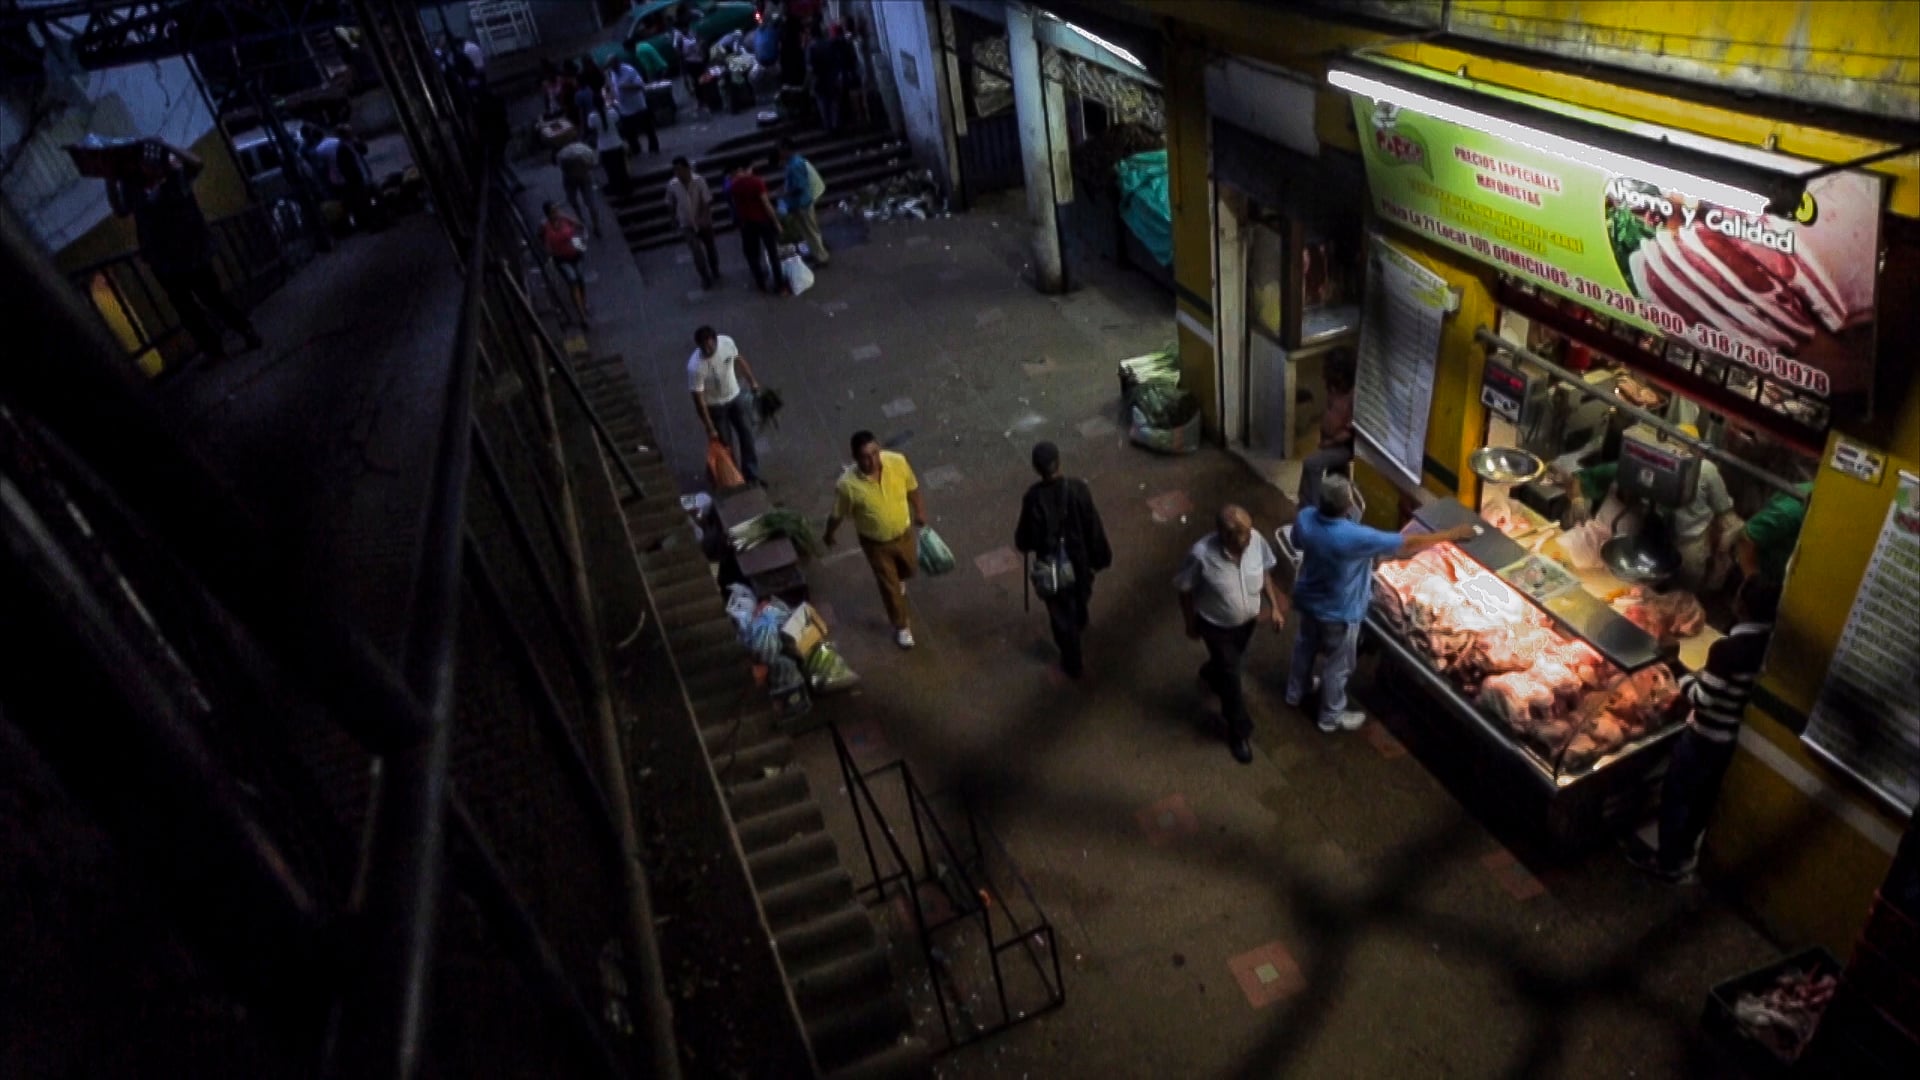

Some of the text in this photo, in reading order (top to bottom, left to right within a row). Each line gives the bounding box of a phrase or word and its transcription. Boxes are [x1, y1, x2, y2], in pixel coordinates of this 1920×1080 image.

[1454, 146, 1561, 193] PRECIOS ESPECIALES
[1476, 172, 1542, 207] MAYORISTAS
[1604, 178, 1795, 255] Ahorro y Calidad
[1575, 276, 1602, 300] 310
[1638, 302, 1685, 335] 5800
